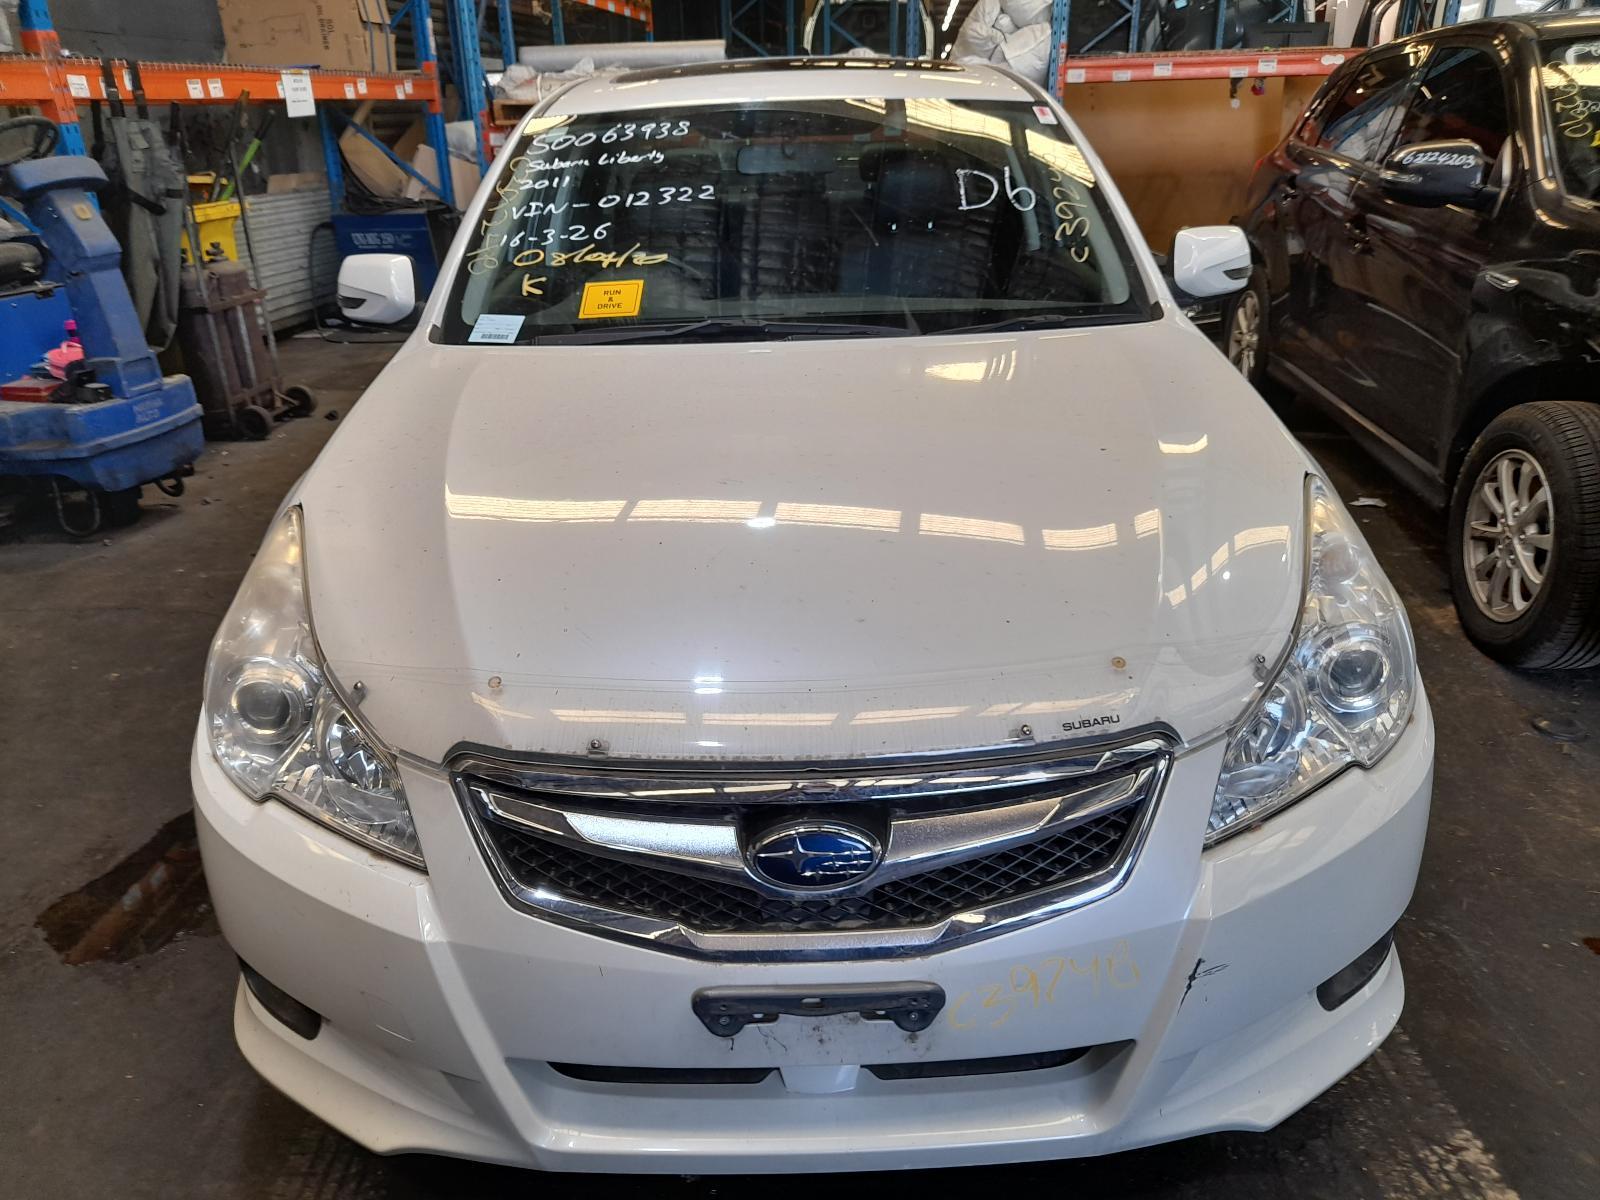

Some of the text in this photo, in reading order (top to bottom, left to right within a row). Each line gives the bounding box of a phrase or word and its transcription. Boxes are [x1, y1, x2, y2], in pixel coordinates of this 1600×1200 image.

[518, 175, 571, 191] 2011
[499, 222, 612, 248] 16-3-26
[521, 273, 548, 297] K
[603, 289, 622, 297] RUN
[597, 302, 623, 310] DRIVE
[1061, 714, 1121, 732] SUBARU
